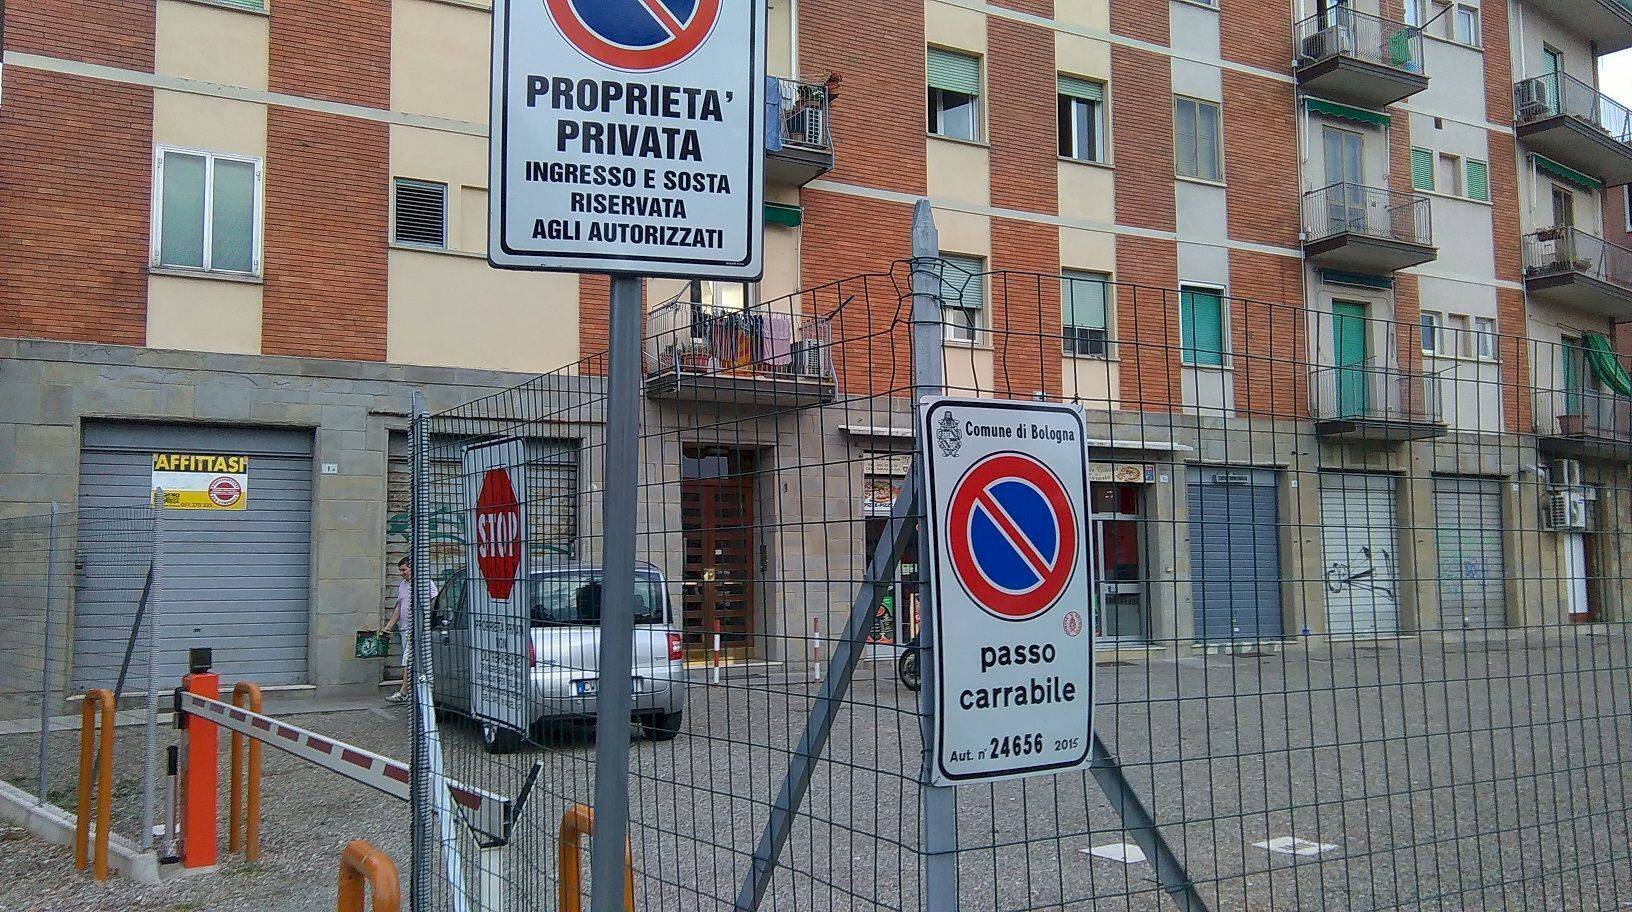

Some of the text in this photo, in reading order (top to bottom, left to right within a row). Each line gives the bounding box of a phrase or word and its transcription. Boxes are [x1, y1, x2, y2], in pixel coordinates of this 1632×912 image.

[526, 75, 734, 122] PROPRIETA'
[557, 119, 703, 162] PRIVATA
[525, 161, 731, 194] INGRESSO E SOSTA
[571, 192, 687, 219] RISERVATA
[532, 219, 723, 249] AGLI AUTORIZZATI
[965, 421, 1075, 443] Comune di Bologna
[155, 454, 244, 473] AFFITTASI
[478, 511, 517, 558] STOP
[981, 643, 1056, 673] passo
[959, 677, 1076, 711] carrabile
[990, 733, 1043, 759] 24656
[1054, 737, 1080, 752] 2015
